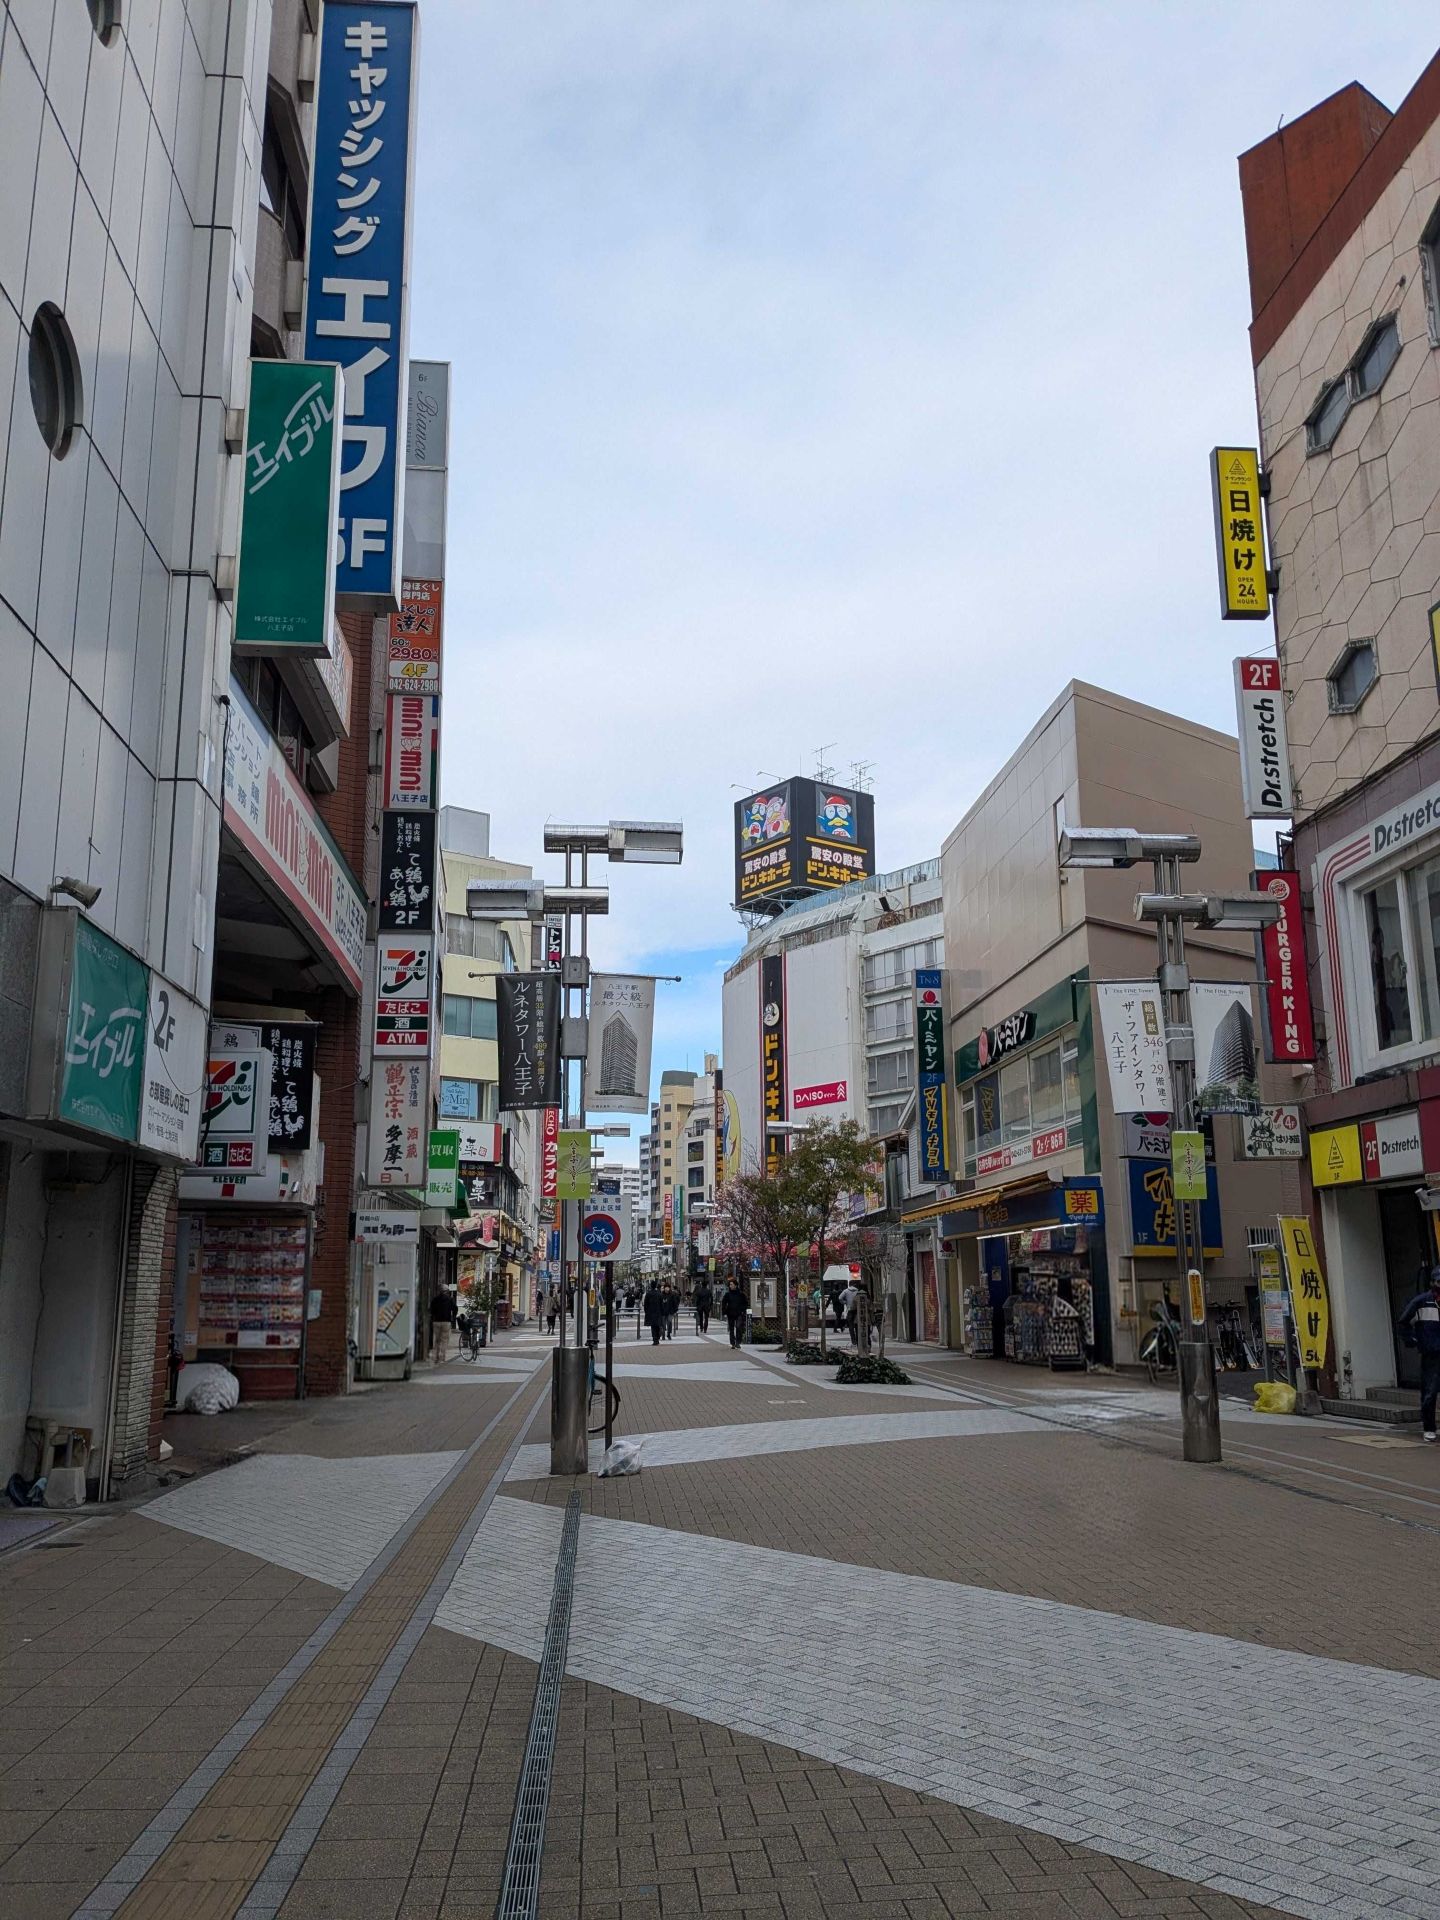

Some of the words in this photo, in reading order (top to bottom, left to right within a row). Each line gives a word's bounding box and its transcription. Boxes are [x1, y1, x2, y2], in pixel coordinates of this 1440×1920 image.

[333, 20, 388, 256] キャッシング
[415, 390, 439, 460] Bianca
[247, 383, 334, 493] エイブル
[1229, 489, 1256, 571] 日焼け
[1238, 583, 1256, 598] 24
[389, 647, 432, 660] 2980
[400, 662, 428, 677] 4F
[1249, 664, 1273, 686] 2F
[391, 793, 428, 803] 八王子店
[395, 910, 420, 925] 2F
[385, 1002, 421, 1014] たばこ
[153, 990, 176, 1053] 2F
[394, 1017, 411, 1029] 酒
[1282, 995, 1300, 1054] KING
[66, 1001, 142, 1079] エイブル
[386, 1032, 417, 1044] ATM
[513, 981, 533, 1096] ルネタワー八王子
[922, 1009, 939, 1071] バーミヤン
[993, 1011, 1028, 1057] バーミヤン
[1110, 1031, 1128, 1074] 八王子
[1121, 1000, 1146, 1107] ザ・ファインタワー
[926, 1073, 939, 1083] 2F
[795, 1090, 823, 1103] DAISO
[547, 1110, 555, 1135] ECHO
[923, 1085, 940, 1168] マツモトキヨシ
[1284, 1115, 1296, 1129] 4F
[208, 1147, 223, 1163] 酒
[229, 1147, 252, 1163] たばこ
[430, 1144, 454, 1157] 買取
[1136, 1136, 1170, 1154] バーミヤ
[1365, 1140, 1377, 1161] 2F
[1381, 1135, 1420, 1155] Dr.stretch
[543, 1142, 558, 1193] カラオケ
[931, 1171, 942, 1180] 1F
[212, 1175, 246, 1184] ELEVEN
[429, 1181, 453, 1194] 販売
[1070, 1191, 1094, 1213] 薬
[1137, 1232, 1149, 1244] 1F
[1292, 1228, 1322, 1339] 日焼け
